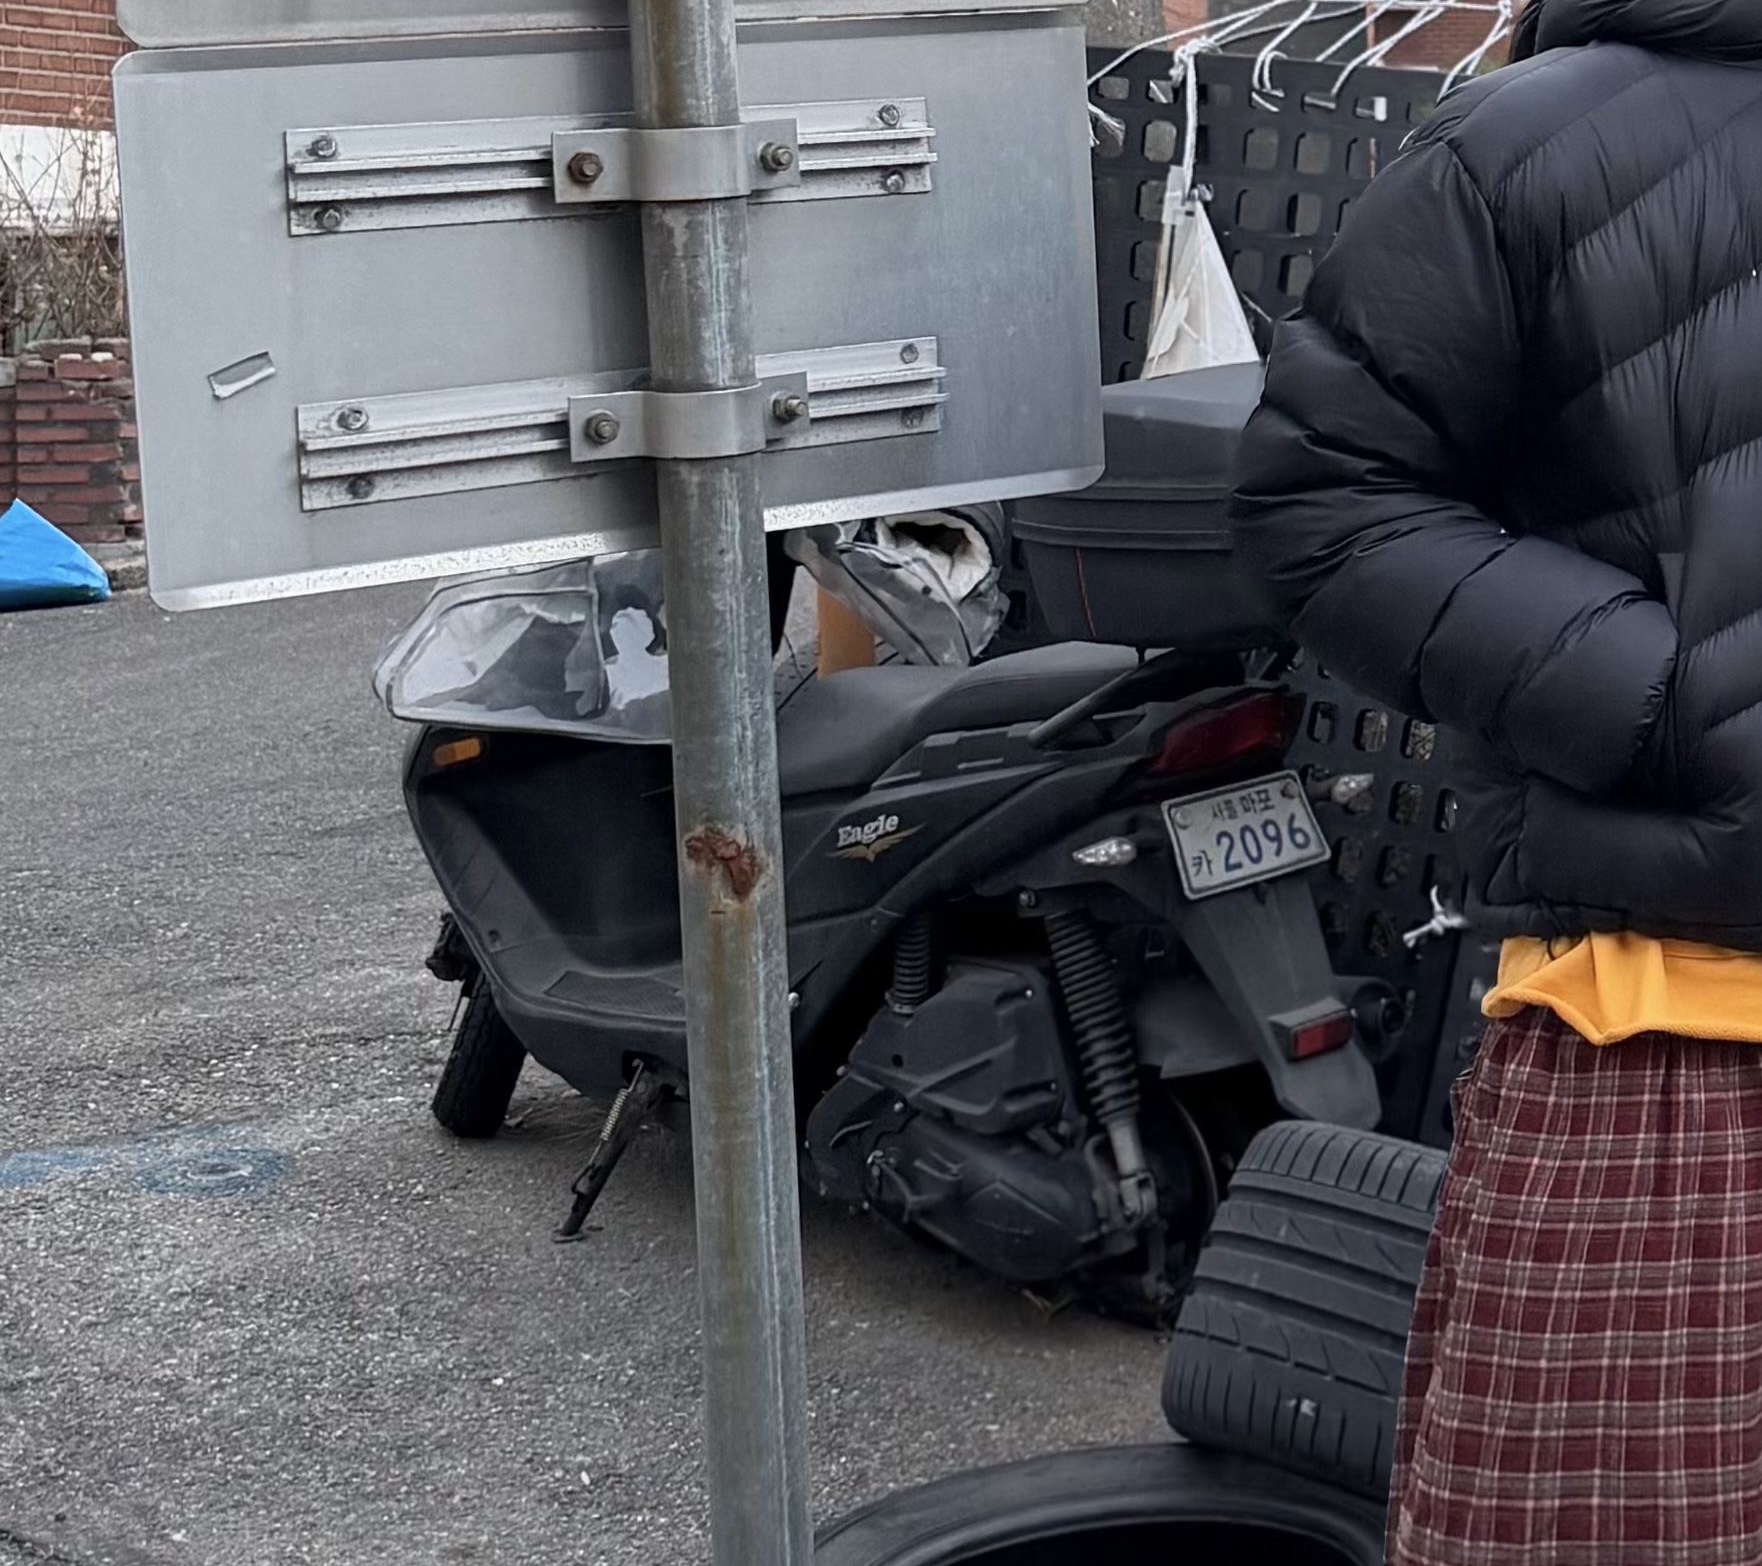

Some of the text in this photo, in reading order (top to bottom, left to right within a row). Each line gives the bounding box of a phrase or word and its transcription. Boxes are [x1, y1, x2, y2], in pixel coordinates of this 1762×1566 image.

[1240, 789, 1275, 814] 마포
[837, 814, 899, 847] Eagle
[1191, 812, 1312, 877] 카 2096
